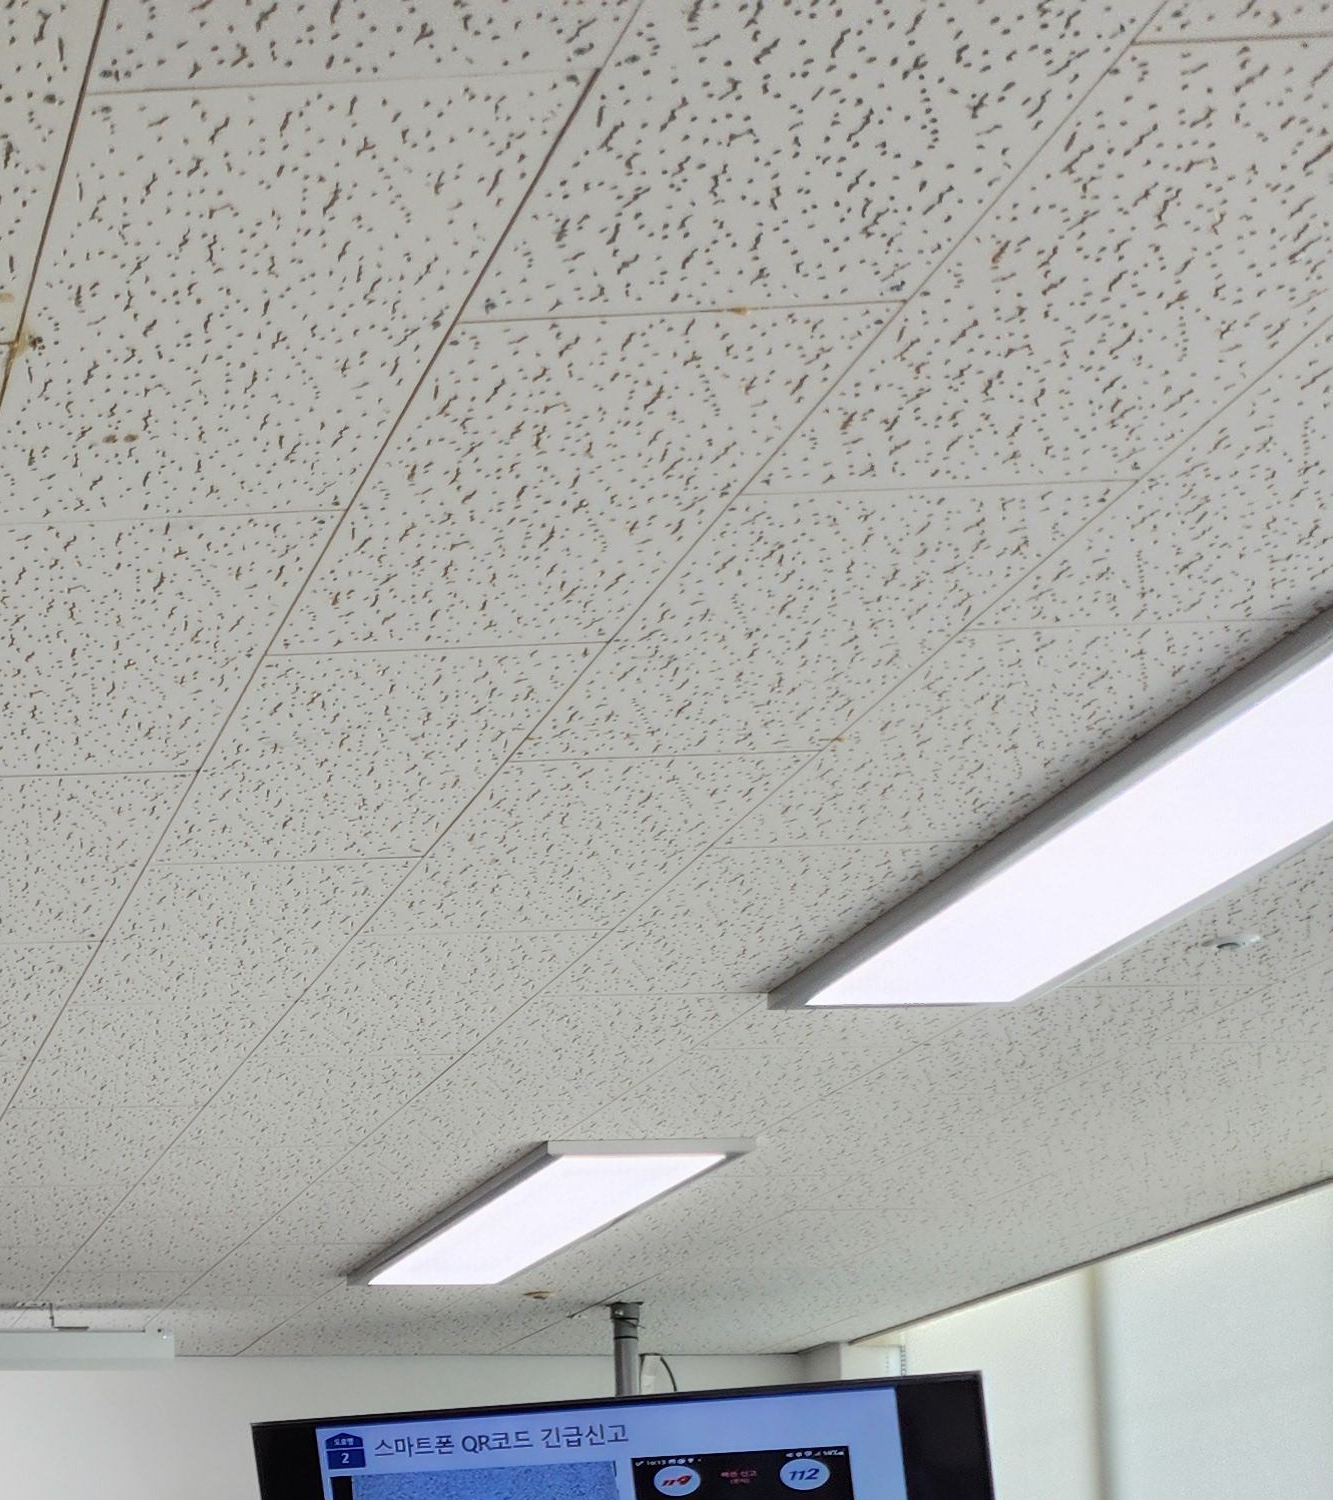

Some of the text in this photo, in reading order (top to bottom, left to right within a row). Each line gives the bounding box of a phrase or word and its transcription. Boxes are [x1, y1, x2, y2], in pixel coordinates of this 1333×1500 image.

[374, 1423, 629, 1458] 스마트폰 QR코드 긴급신고
[341, 1452, 350, 1465] 2
[789, 1468, 820, 1481] 112
